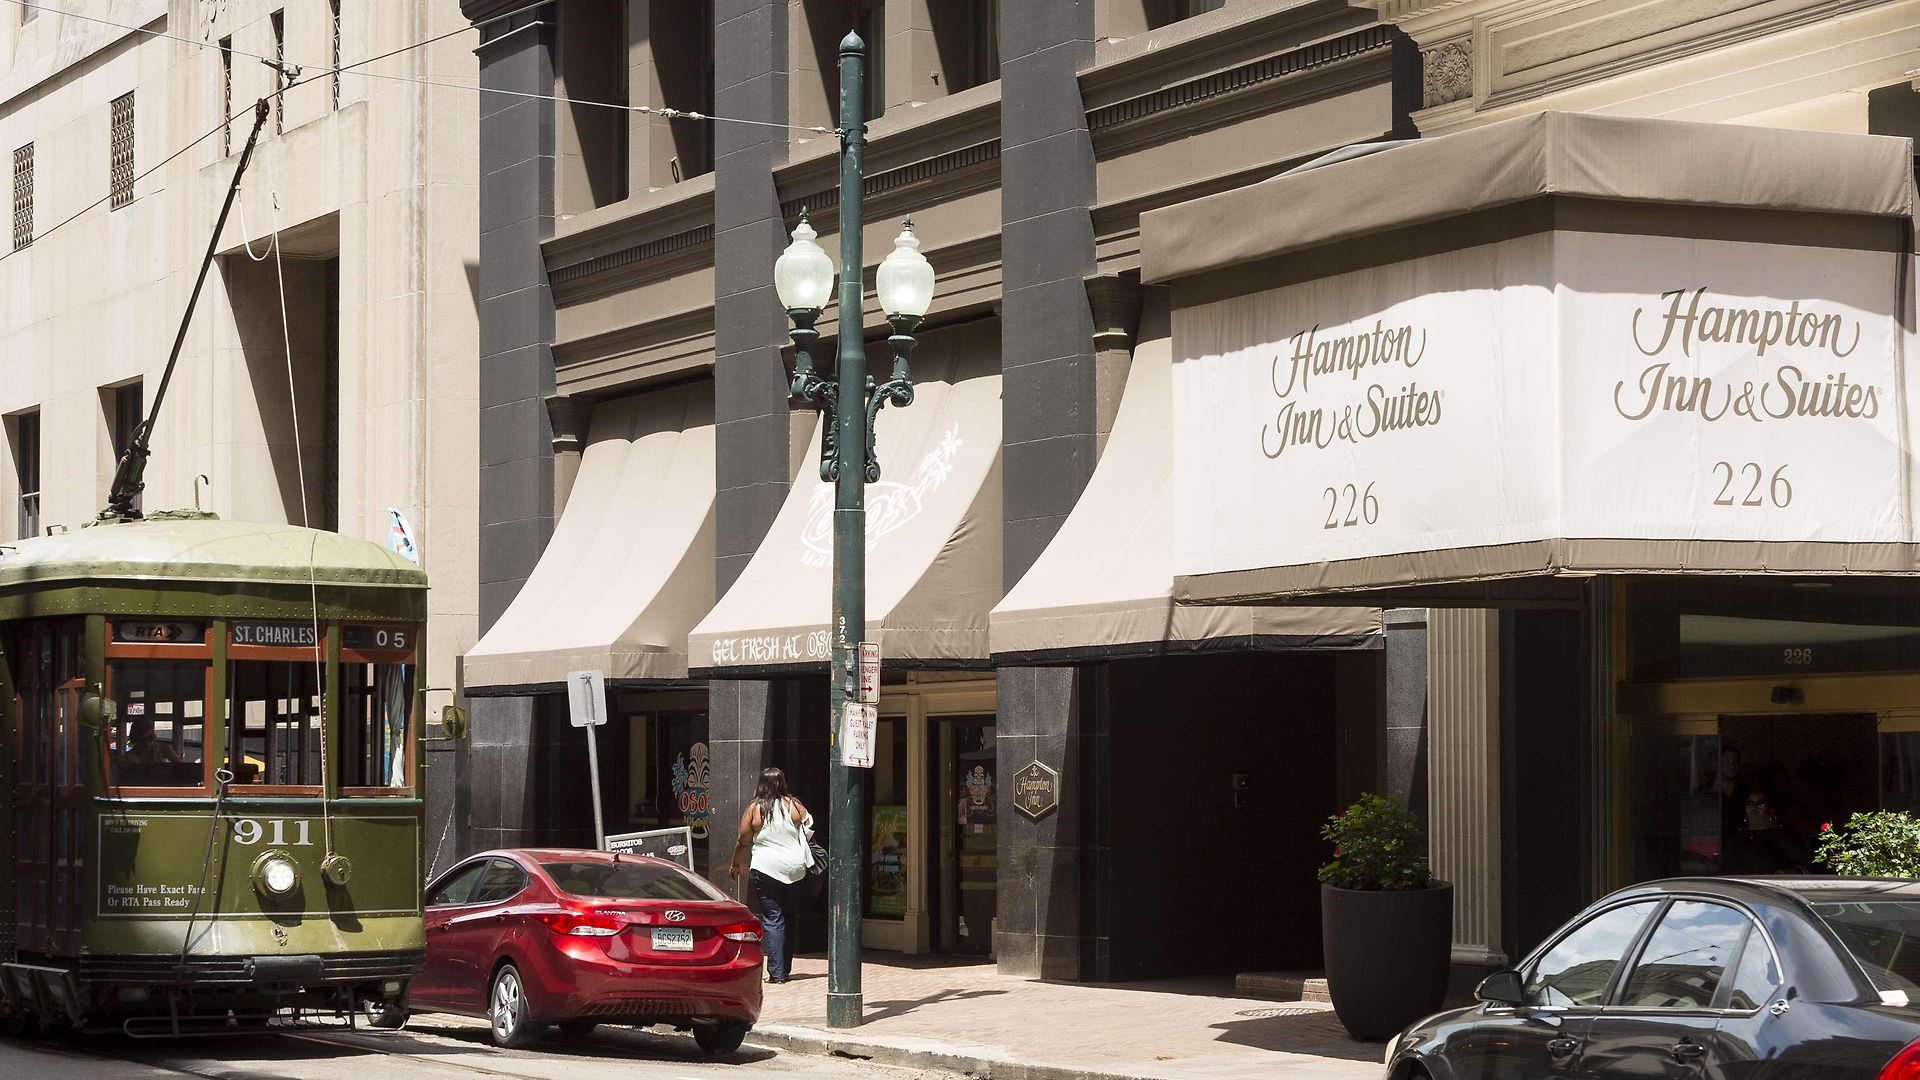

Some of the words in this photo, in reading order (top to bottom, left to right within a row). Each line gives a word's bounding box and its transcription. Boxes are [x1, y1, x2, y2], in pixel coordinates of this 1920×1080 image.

[1633, 286, 1860, 358] Hampton
[1272, 320, 1426, 398] Hampton
[1614, 362, 1731, 422] Inn
[1733, 381, 1763, 422] &
[1262, 400, 1336, 459] Inn
[1337, 405, 1357, 443] &
[1713, 462, 1793, 508] 226
[1323, 481, 1379, 529] 226
[135, 626, 164, 637] RTA
[235, 625, 253, 643] ST.
[256, 625, 315, 645] CHARLES
[712, 639, 740, 665] GET
[740, 637, 779, 662] FRESH
[783, 635, 803, 660] AT
[1784, 648, 1812, 665] 226
[1016, 776, 1053, 795] Hampton
[1025, 791, 1043, 810] Inn
[234, 819, 314, 846] 911
[610, 838, 643, 849] BURRITOS
[108, 885, 133, 895] Please
[136, 885, 158, 895] Have
[160, 885, 185, 895] Exact
[108, 897, 119, 907] Or
[122, 897, 140, 907] RTA
[143, 897, 162, 907] Pass
[164, 897, 190, 908] Ready
